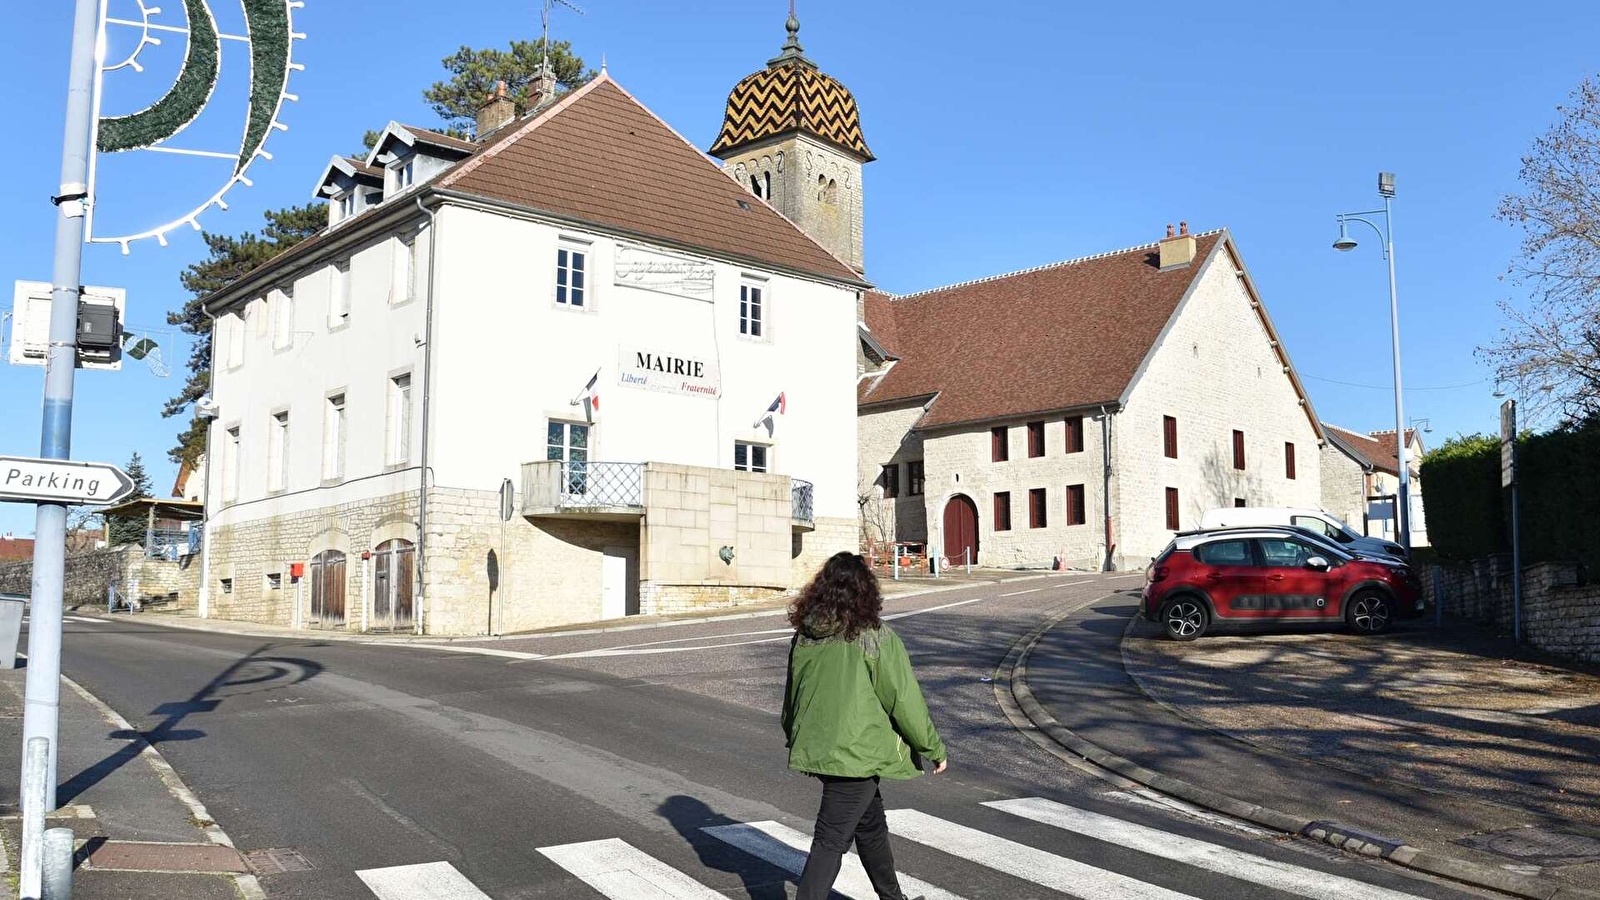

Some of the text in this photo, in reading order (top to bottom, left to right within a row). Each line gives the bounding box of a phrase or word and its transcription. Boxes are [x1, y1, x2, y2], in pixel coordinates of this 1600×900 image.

[636, 351, 704, 378] MAIRIE
[621, 372, 648, 385] Liberté
[681, 381, 718, 396] Fraternité
[5, 468, 100, 496] Parking
